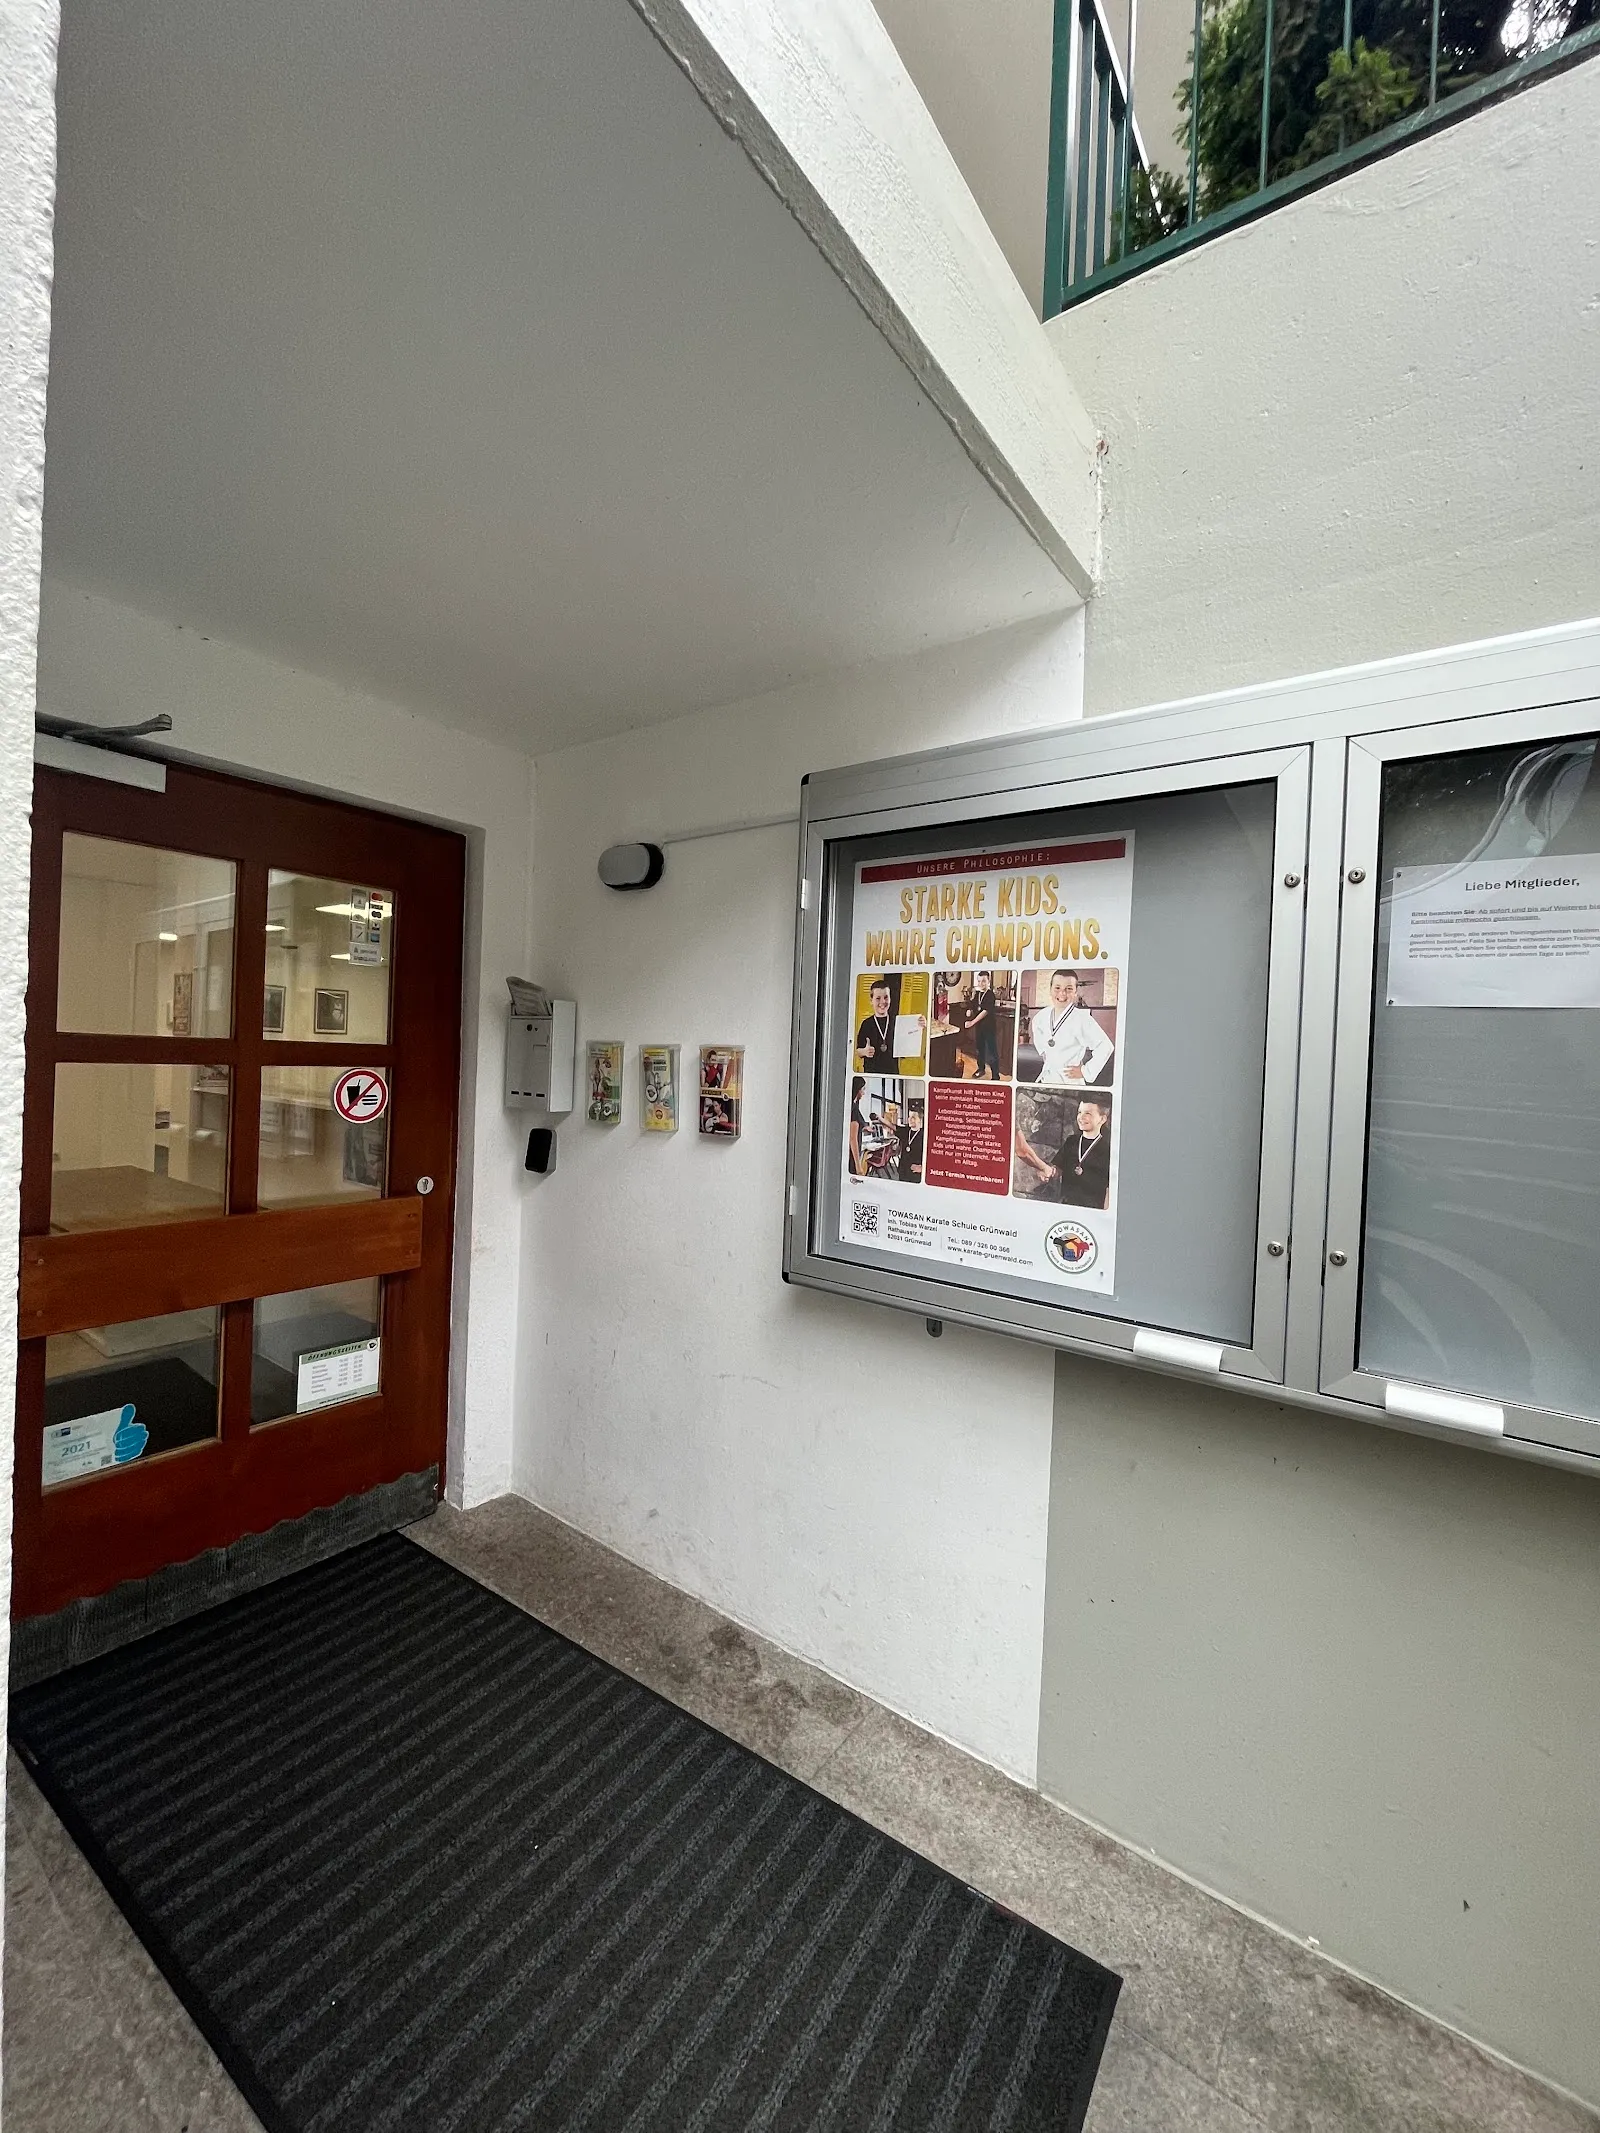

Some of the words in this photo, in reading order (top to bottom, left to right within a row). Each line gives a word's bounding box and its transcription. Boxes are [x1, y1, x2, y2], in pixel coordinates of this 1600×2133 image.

[1465, 881, 1501, 891] Liebe
[1505, 877, 1580, 890] Mitglieder,
[900, 881, 986, 923] STARKE
[997, 874, 1066, 918] KIDS.
[865, 927, 936, 966] WAHRE
[946, 918, 1108, 963] CHAMPIONS.
[967, 1174, 1003, 1183] vereinbaren!
[888, 1209, 924, 1221] TOWASAN
[926, 1216, 949, 1226] Karate
[952, 1220, 977, 1231] Schule
[980, 1225, 1017, 1238] Grünwald
[904, 1236, 931, 1246] Grünwald
[1054, 1225, 1089, 1241] TOWASAN
[62, 1441, 91, 1457] 2021
